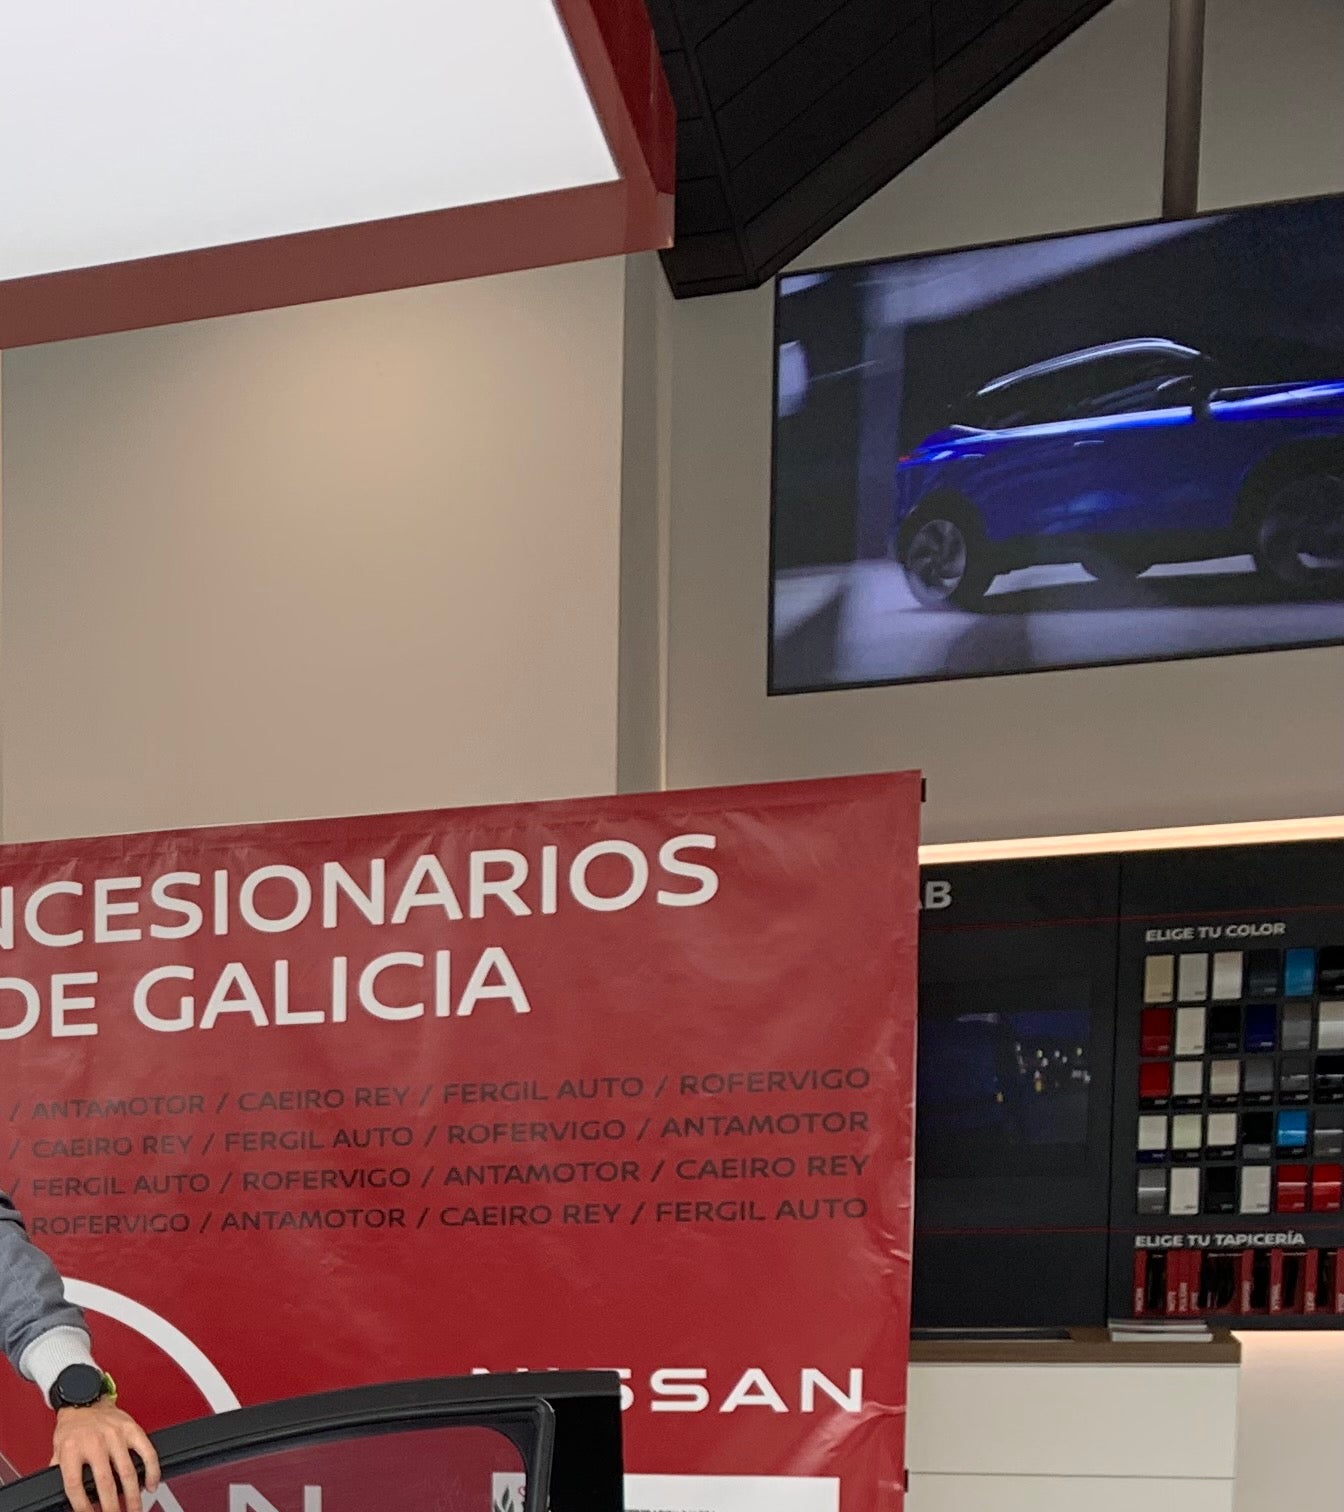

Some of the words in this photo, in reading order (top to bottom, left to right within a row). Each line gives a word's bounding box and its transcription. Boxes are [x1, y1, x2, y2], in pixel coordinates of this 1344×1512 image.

[1145, 927, 1196, 942] ELIGE
[1197, 926, 1222, 940] TU
[1225, 922, 1286, 938] COLOR
[132, 946, 531, 1034] GALICIA
[32, 1095, 205, 1121] ANTAMOTOR
[237, 1088, 346, 1113] CAEIRO
[354, 1086, 410, 1108] REY
[443, 1080, 549, 1105] FERGIL
[556, 1076, 645, 1101] AUTO
[679, 1067, 872, 1097] ROFERVIGO
[32, 1135, 135, 1159] CAEIRO
[143, 1133, 195, 1156] REY
[225, 1128, 325, 1152] FERGIL
[333, 1125, 415, 1150] AUTO
[448, 1119, 627, 1146] ROFERVIGO
[661, 1110, 870, 1140] ANTAMOTOR
[33, 1174, 127, 1198] FERGIL
[134, 1171, 212, 1196] AUTO
[242, 1166, 412, 1192] ROFERVIGO
[443, 1159, 642, 1188] ANTAMOTOR
[675, 1156, 797, 1182] CAEIRO
[807, 1154, 872, 1177] REY
[221, 1206, 408, 1232] ANTAMOTOR
[439, 1202, 554, 1227] CAEIRO
[564, 1201, 622, 1224] REY
[656, 1199, 766, 1223] FERGIL
[775, 1196, 868, 1221] AUTO
[1135, 1235, 1185, 1248] ELIGE
[1187, 1234, 1211, 1247] TU
